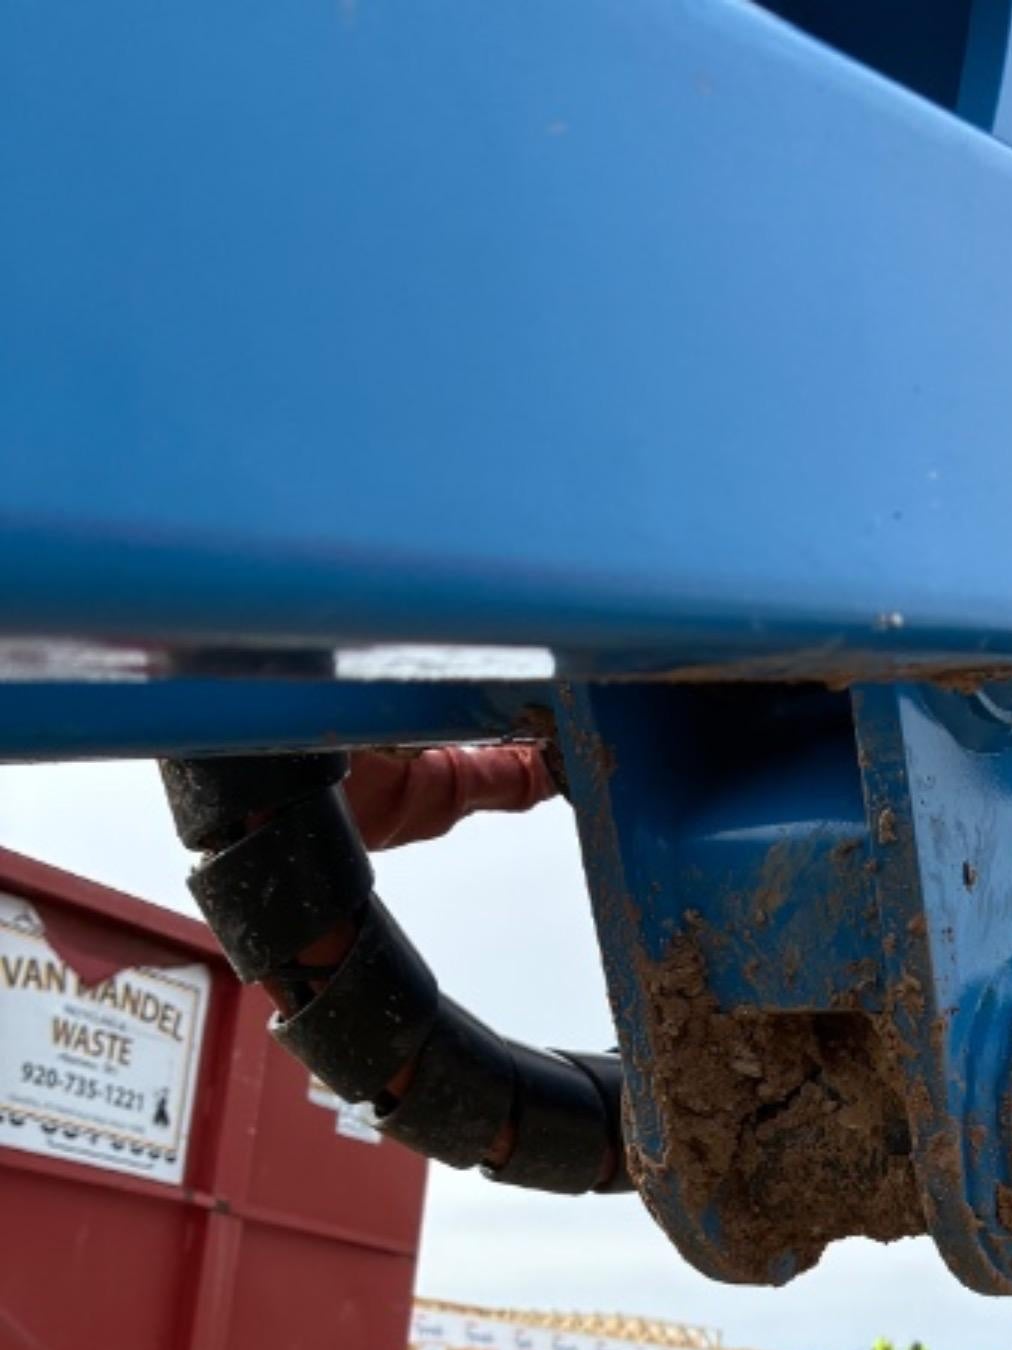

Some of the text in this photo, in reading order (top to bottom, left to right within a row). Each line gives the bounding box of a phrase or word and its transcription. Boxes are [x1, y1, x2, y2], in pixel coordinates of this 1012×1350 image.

[0, 955, 67, 994] VAN
[52, 1015, 133, 1066] WASTE
[21, 1061, 146, 1112] 920-735-1221
